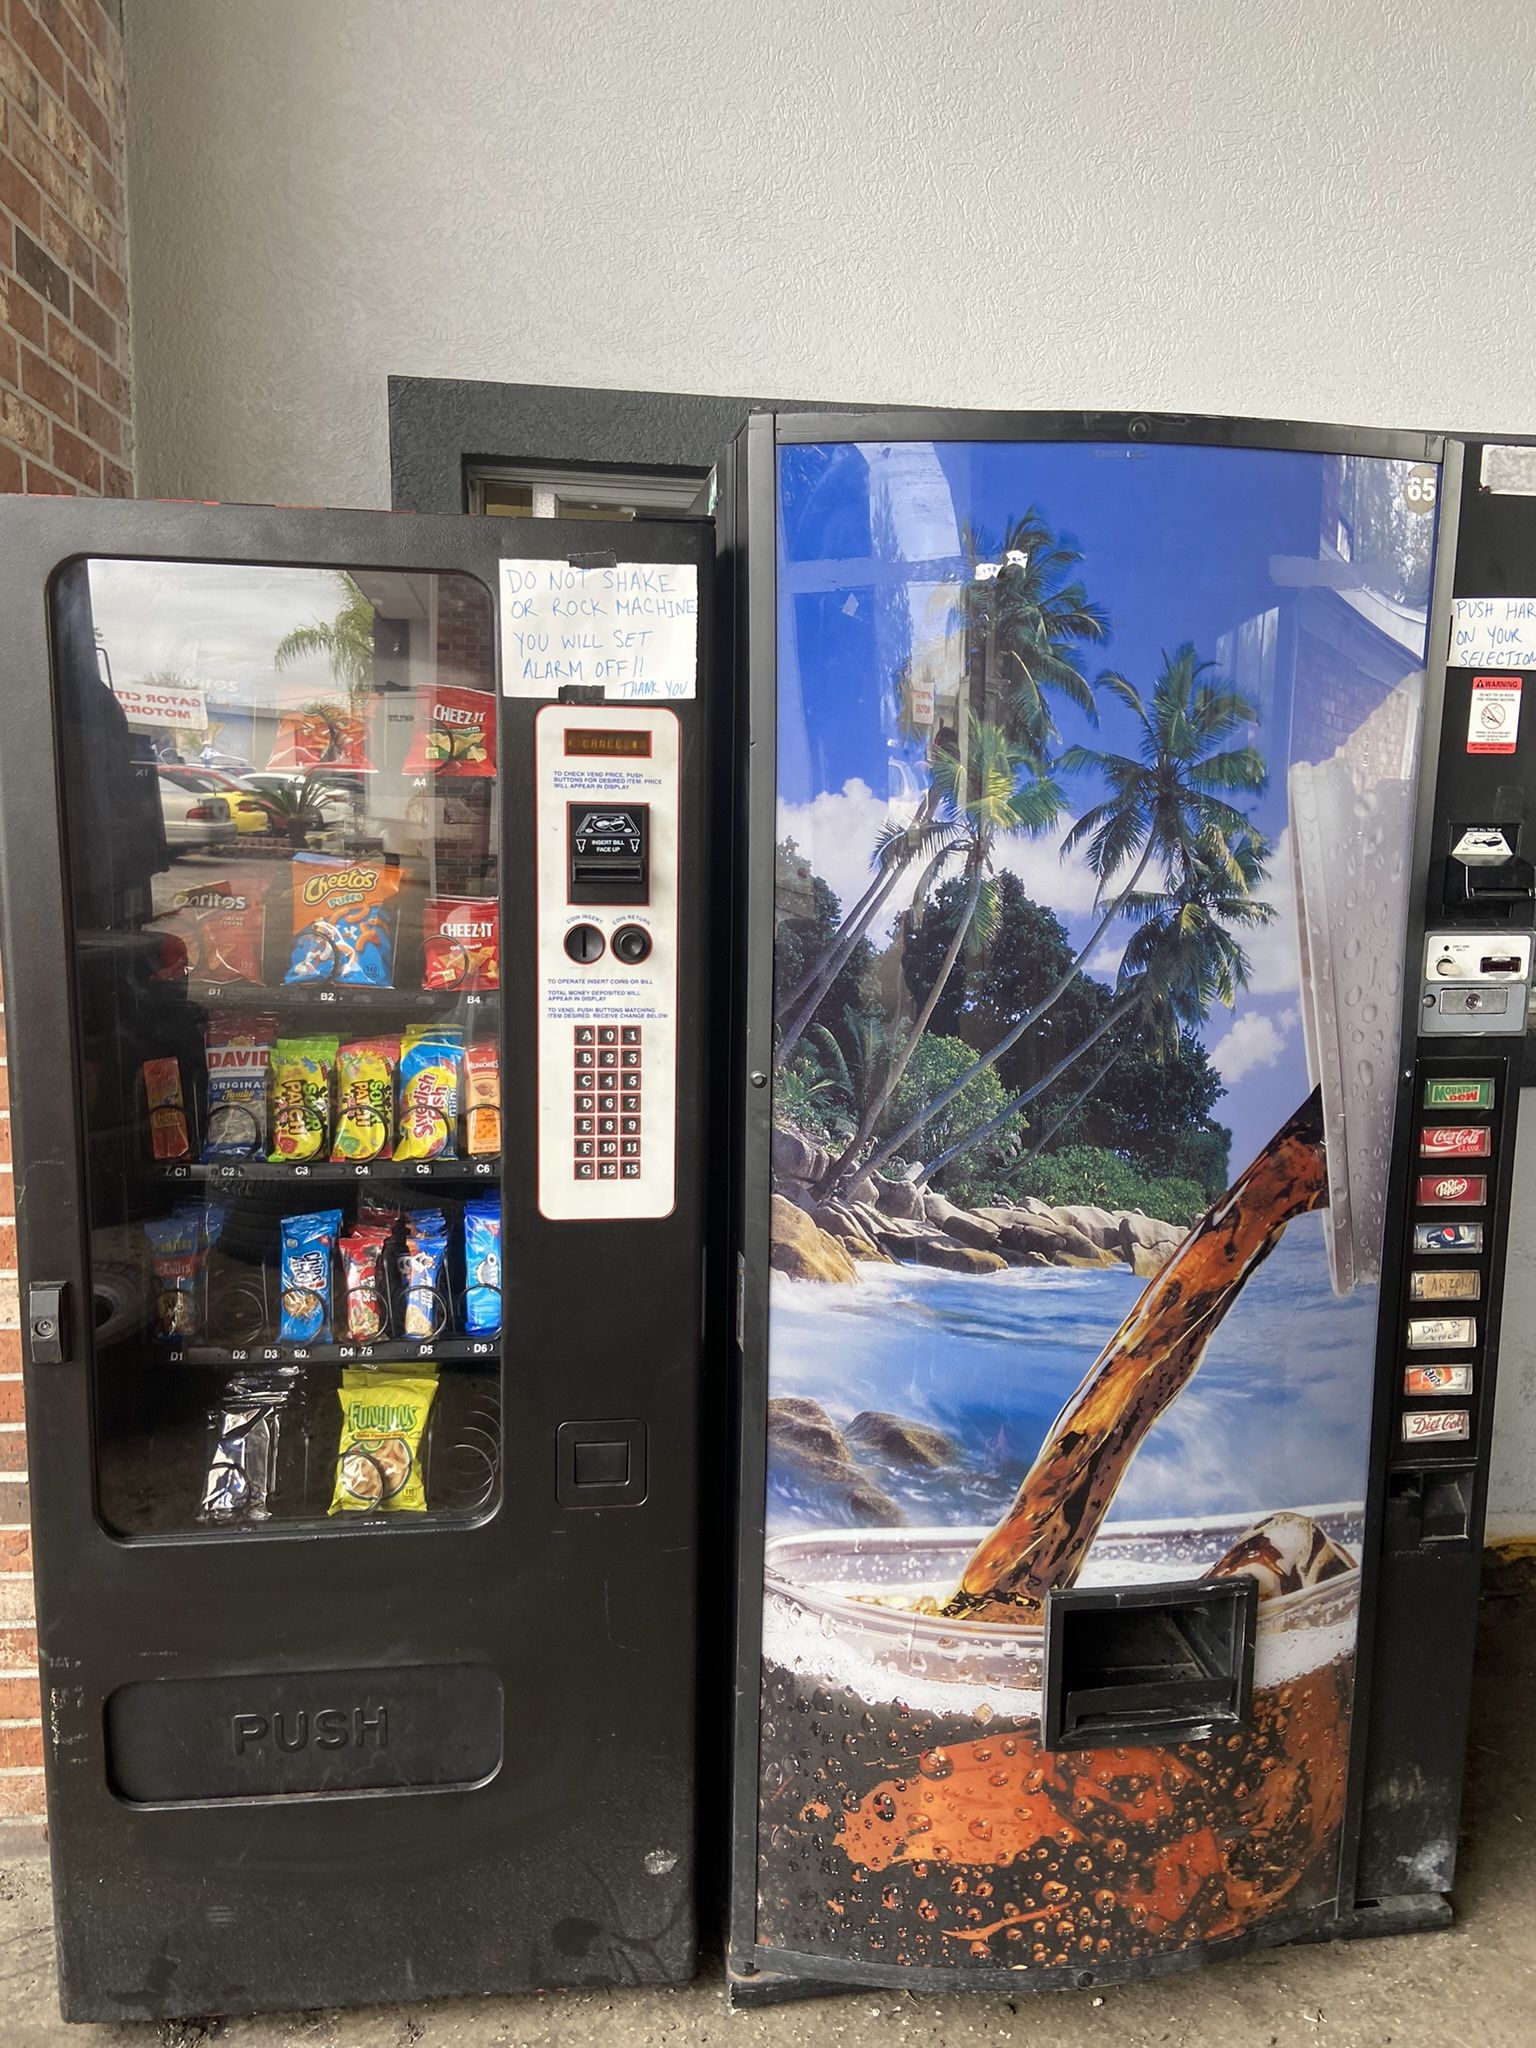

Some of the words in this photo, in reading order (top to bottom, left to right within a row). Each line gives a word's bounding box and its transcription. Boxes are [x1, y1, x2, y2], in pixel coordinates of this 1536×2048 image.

[1407, 477, 1435, 501] 65
[506, 569, 536, 593] DO
[550, 569, 590, 591] NOT
[603, 570, 676, 593] SHAKE
[511, 598, 539, 619] OR
[553, 598, 608, 618] ROCK
[617, 598, 697, 618] MACHINE
[1456, 600, 1493, 619] PUSH
[1456, 626, 1476, 646] ON
[1487, 626, 1522, 649] YOUR
[514, 632, 548, 658] YOU
[561, 633, 603, 649] WILL
[613, 630, 652, 648] SET
[523, 658, 583, 680] ALARM
[620, 681, 661, 697] THANK
[665, 681, 688, 696] YOU
[413, 778, 427, 786] A4
[304, 867, 378, 905] Cheetos
[173, 893, 246, 910] Doritos
[566, 914, 581, 924] COIN
[582, 914, 604, 924] INSERT
[612, 916, 626, 926] COIN
[628, 914, 651, 926] RETURN
[321, 993, 335, 1001] B2
[467, 996, 481, 1004] B4
[582, 1030, 592, 1041] A
[606, 1031, 614, 1041] 0
[630, 1031, 636, 1041] 1
[208, 1050, 269, 1069] DAVID
[583, 1053, 592, 1064] B
[606, 1053, 614, 1064] 2
[629, 1053, 637, 1064] 3
[467, 1061, 498, 1070] MUNCHIES
[582, 1076, 592, 1087] C
[605, 1076, 613, 1087] 4
[629, 1076, 637, 1087] 5
[413, 1072, 436, 1138] Swedish
[583, 1098, 592, 1109] D
[606, 1098, 613, 1108] 6
[628, 1098, 636, 1108] 7
[582, 1121, 591, 1131] E
[606, 1121, 613, 1131] 8
[628, 1121, 636, 1131] 9
[583, 1143, 592, 1153] F
[603, 1143, 616, 1153] 10
[626, 1143, 637, 1153] 11
[174, 1167, 187, 1177] C1
[221, 1166, 235, 1176] C2
[295, 1166, 309, 1175] C3
[355, 1166, 369, 1175] C4
[416, 1164, 430, 1173] C5
[476, 1164, 490, 1173] C6
[581, 1165, 591, 1174] G
[603, 1165, 616, 1175] 12
[626, 1165, 638, 1175] 13
[1422, 1323, 1444, 1334] DIET
[340, 1348, 353, 1357] D4
[361, 1347, 373, 1355] 75
[420, 1345, 434, 1354] D5
[474, 1344, 487, 1353] D6
[170, 1352, 184, 1361] D1
[233, 1351, 246, 1359] D2
[264, 1350, 278, 1359] D3
[349, 1401, 417, 1432] FUNYUNS
[1412, 1416, 1442, 1434] Diet
[232, 1706, 387, 1756] PUSH
